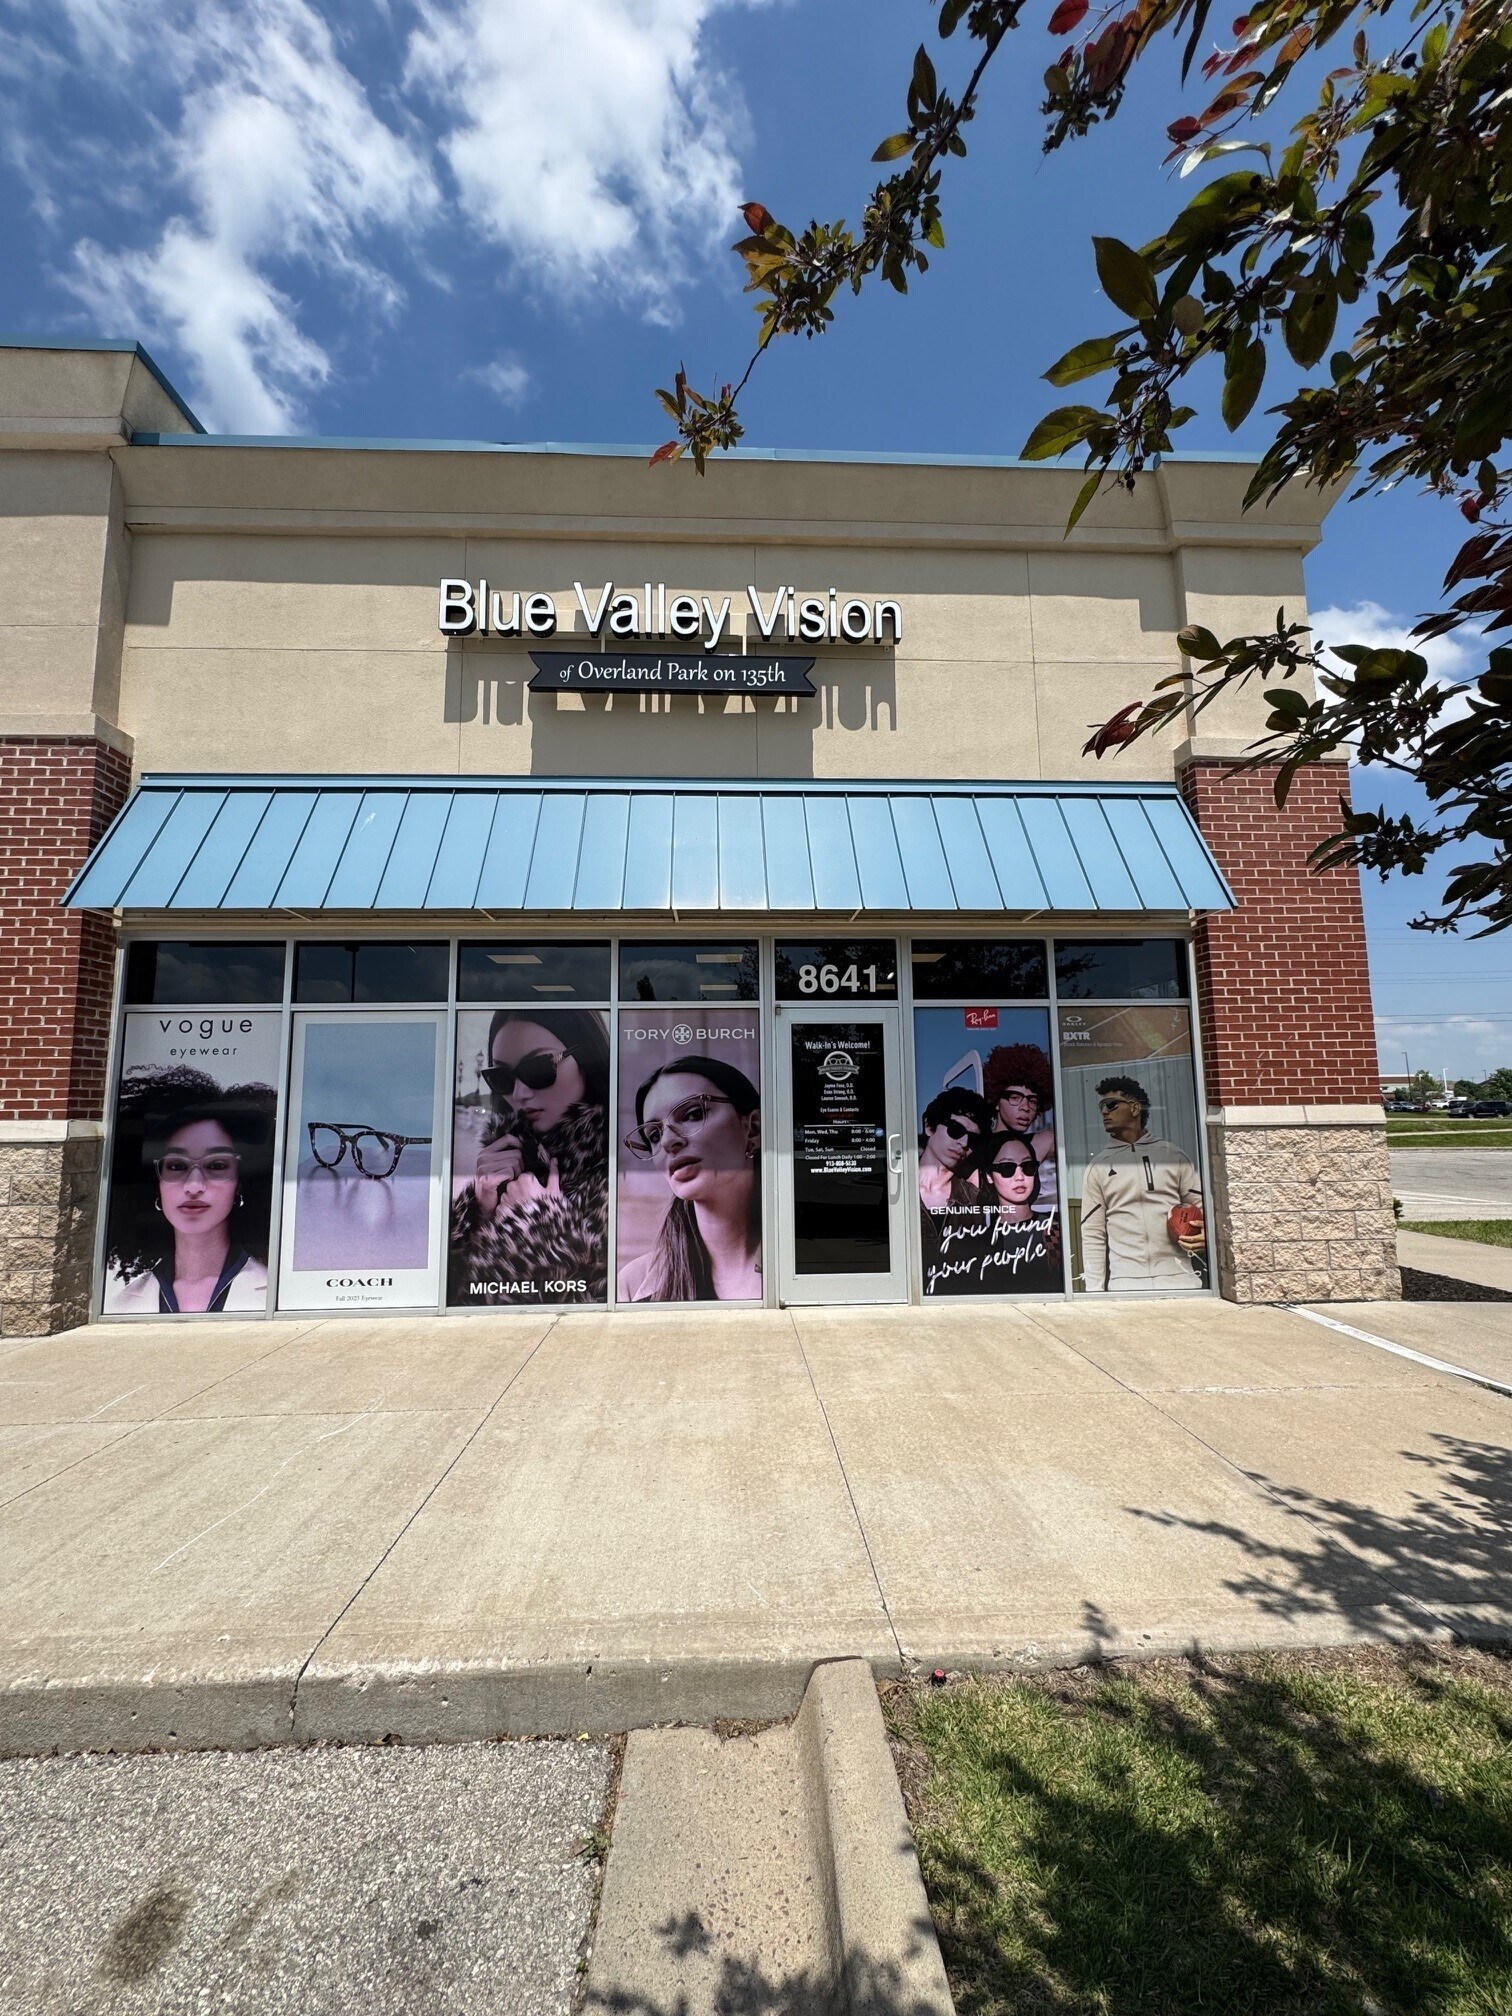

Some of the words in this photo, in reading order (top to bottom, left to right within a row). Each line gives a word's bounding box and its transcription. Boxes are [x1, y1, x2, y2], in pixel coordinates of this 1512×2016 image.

[438, 578, 556, 638] Blue
[573, 580, 732, 653] Valley
[747, 585, 904, 645] Vision
[559, 663, 575, 683] of
[577, 659, 662, 682] Overland
[667, 661, 709, 682] Park
[713, 667, 736, 682] on
[741, 663, 787, 687] 135th
[798, 964, 876, 993] 8641
[158, 1015, 254, 1040] vogue
[624, 1027, 671, 1042] TORY
[695, 1027, 756, 1042] BURCH
[1062, 1031, 1091, 1041] BXTR
[169, 1045, 238, 1058] eyewear
[837, 1041, 871, 1049] Welcome!
[930, 1205, 981, 1215] GENUINE
[982, 1204, 1017, 1214] SINCE
[939, 1219, 990, 1254] you
[990, 1206, 1056, 1244] found
[926, 1256, 979, 1294] your
[980, 1234, 1048, 1282] people
[325, 1277, 394, 1288] COACH
[469, 1281, 539, 1295] MICHAEL
[544, 1280, 587, 1293] KORS
